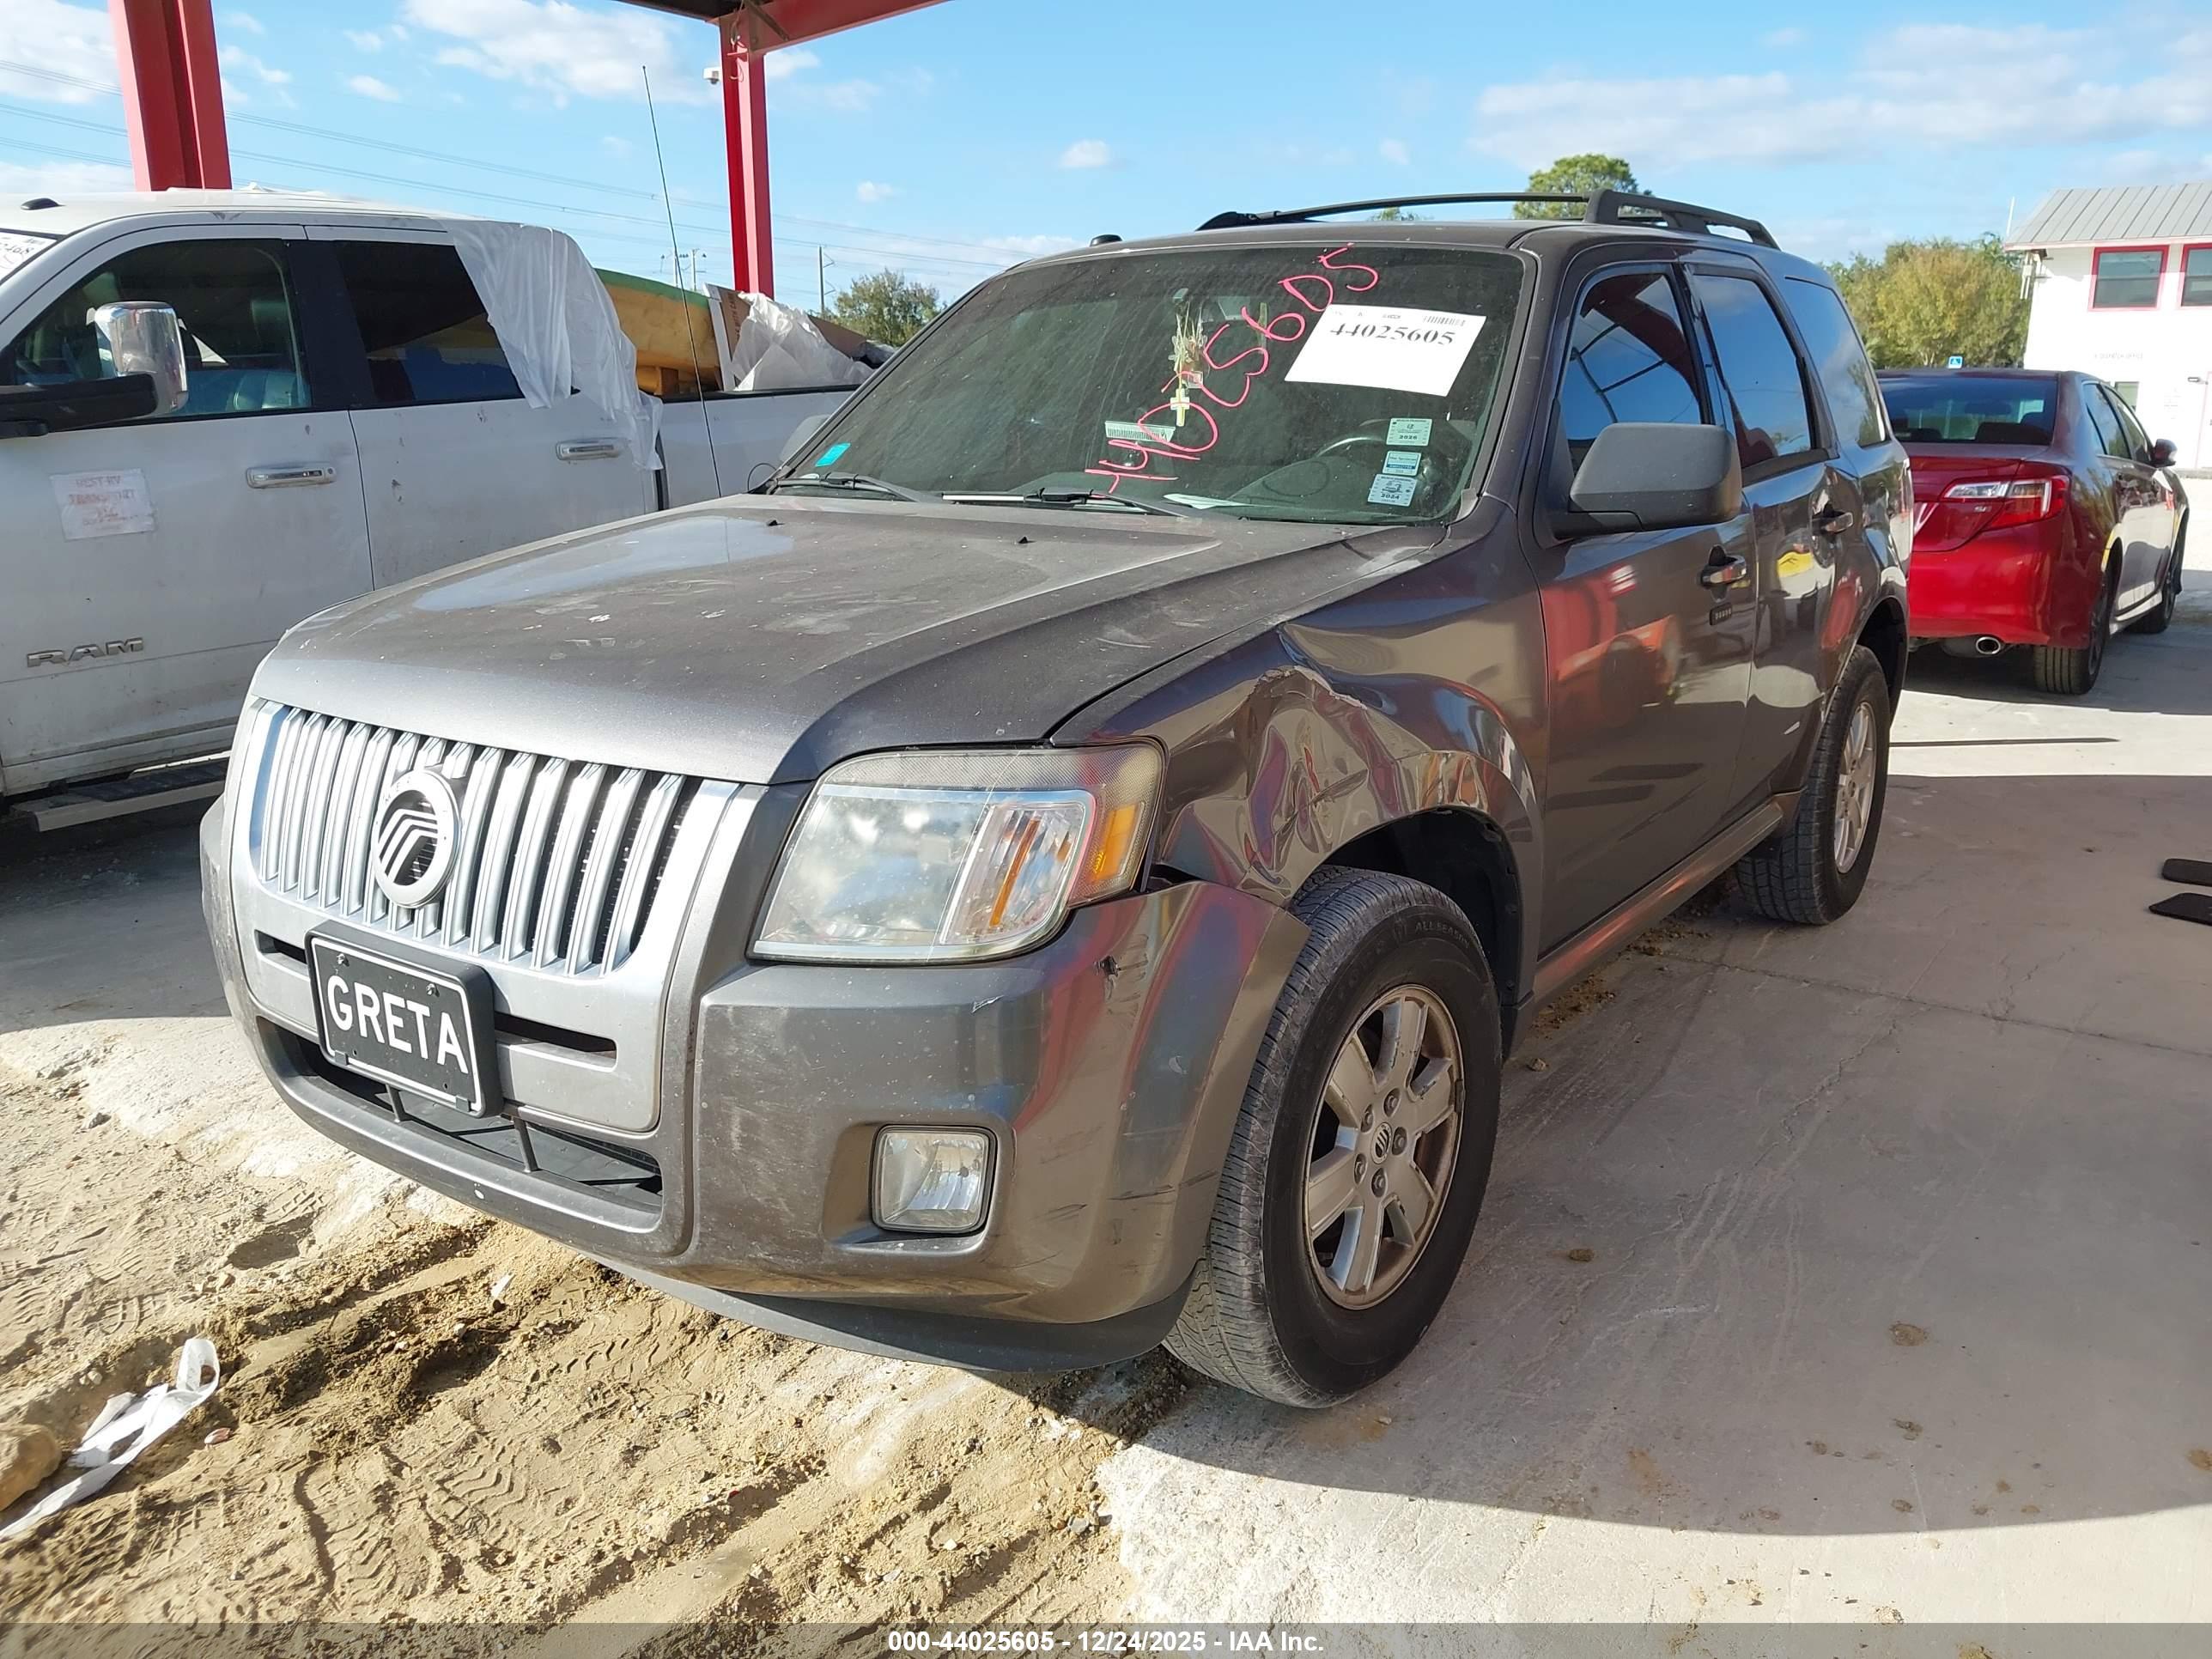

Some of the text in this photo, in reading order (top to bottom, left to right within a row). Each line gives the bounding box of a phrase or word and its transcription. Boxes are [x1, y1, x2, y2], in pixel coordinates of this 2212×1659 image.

[1330, 323, 1455, 345] 44025605
[27, 637, 143, 668] RAM
[327, 975, 468, 1074] GRETA
